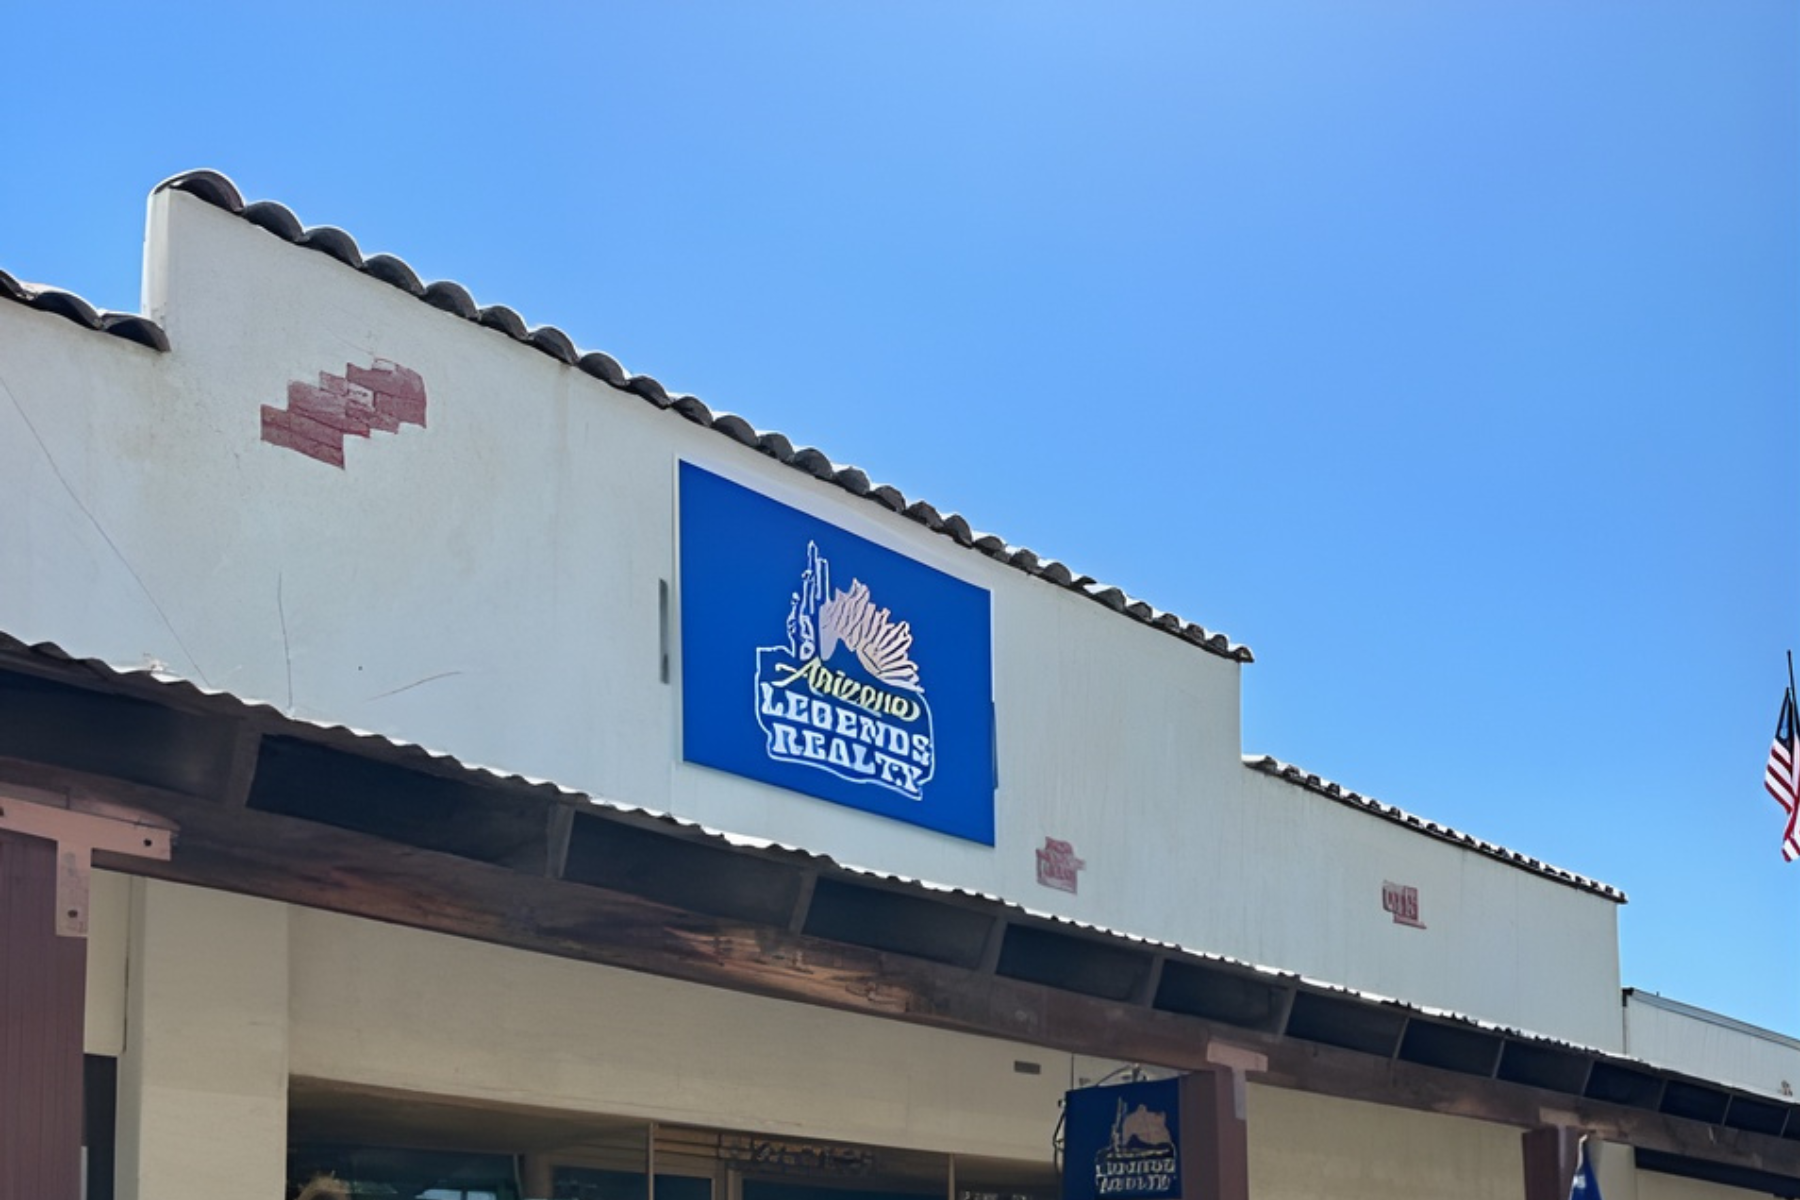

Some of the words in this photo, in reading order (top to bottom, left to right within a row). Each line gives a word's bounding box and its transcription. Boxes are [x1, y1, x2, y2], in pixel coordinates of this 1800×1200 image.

[771, 656, 921, 722] Arizona
[760, 682, 931, 766] LEGENDS
[772, 723, 923, 792] REALTY
